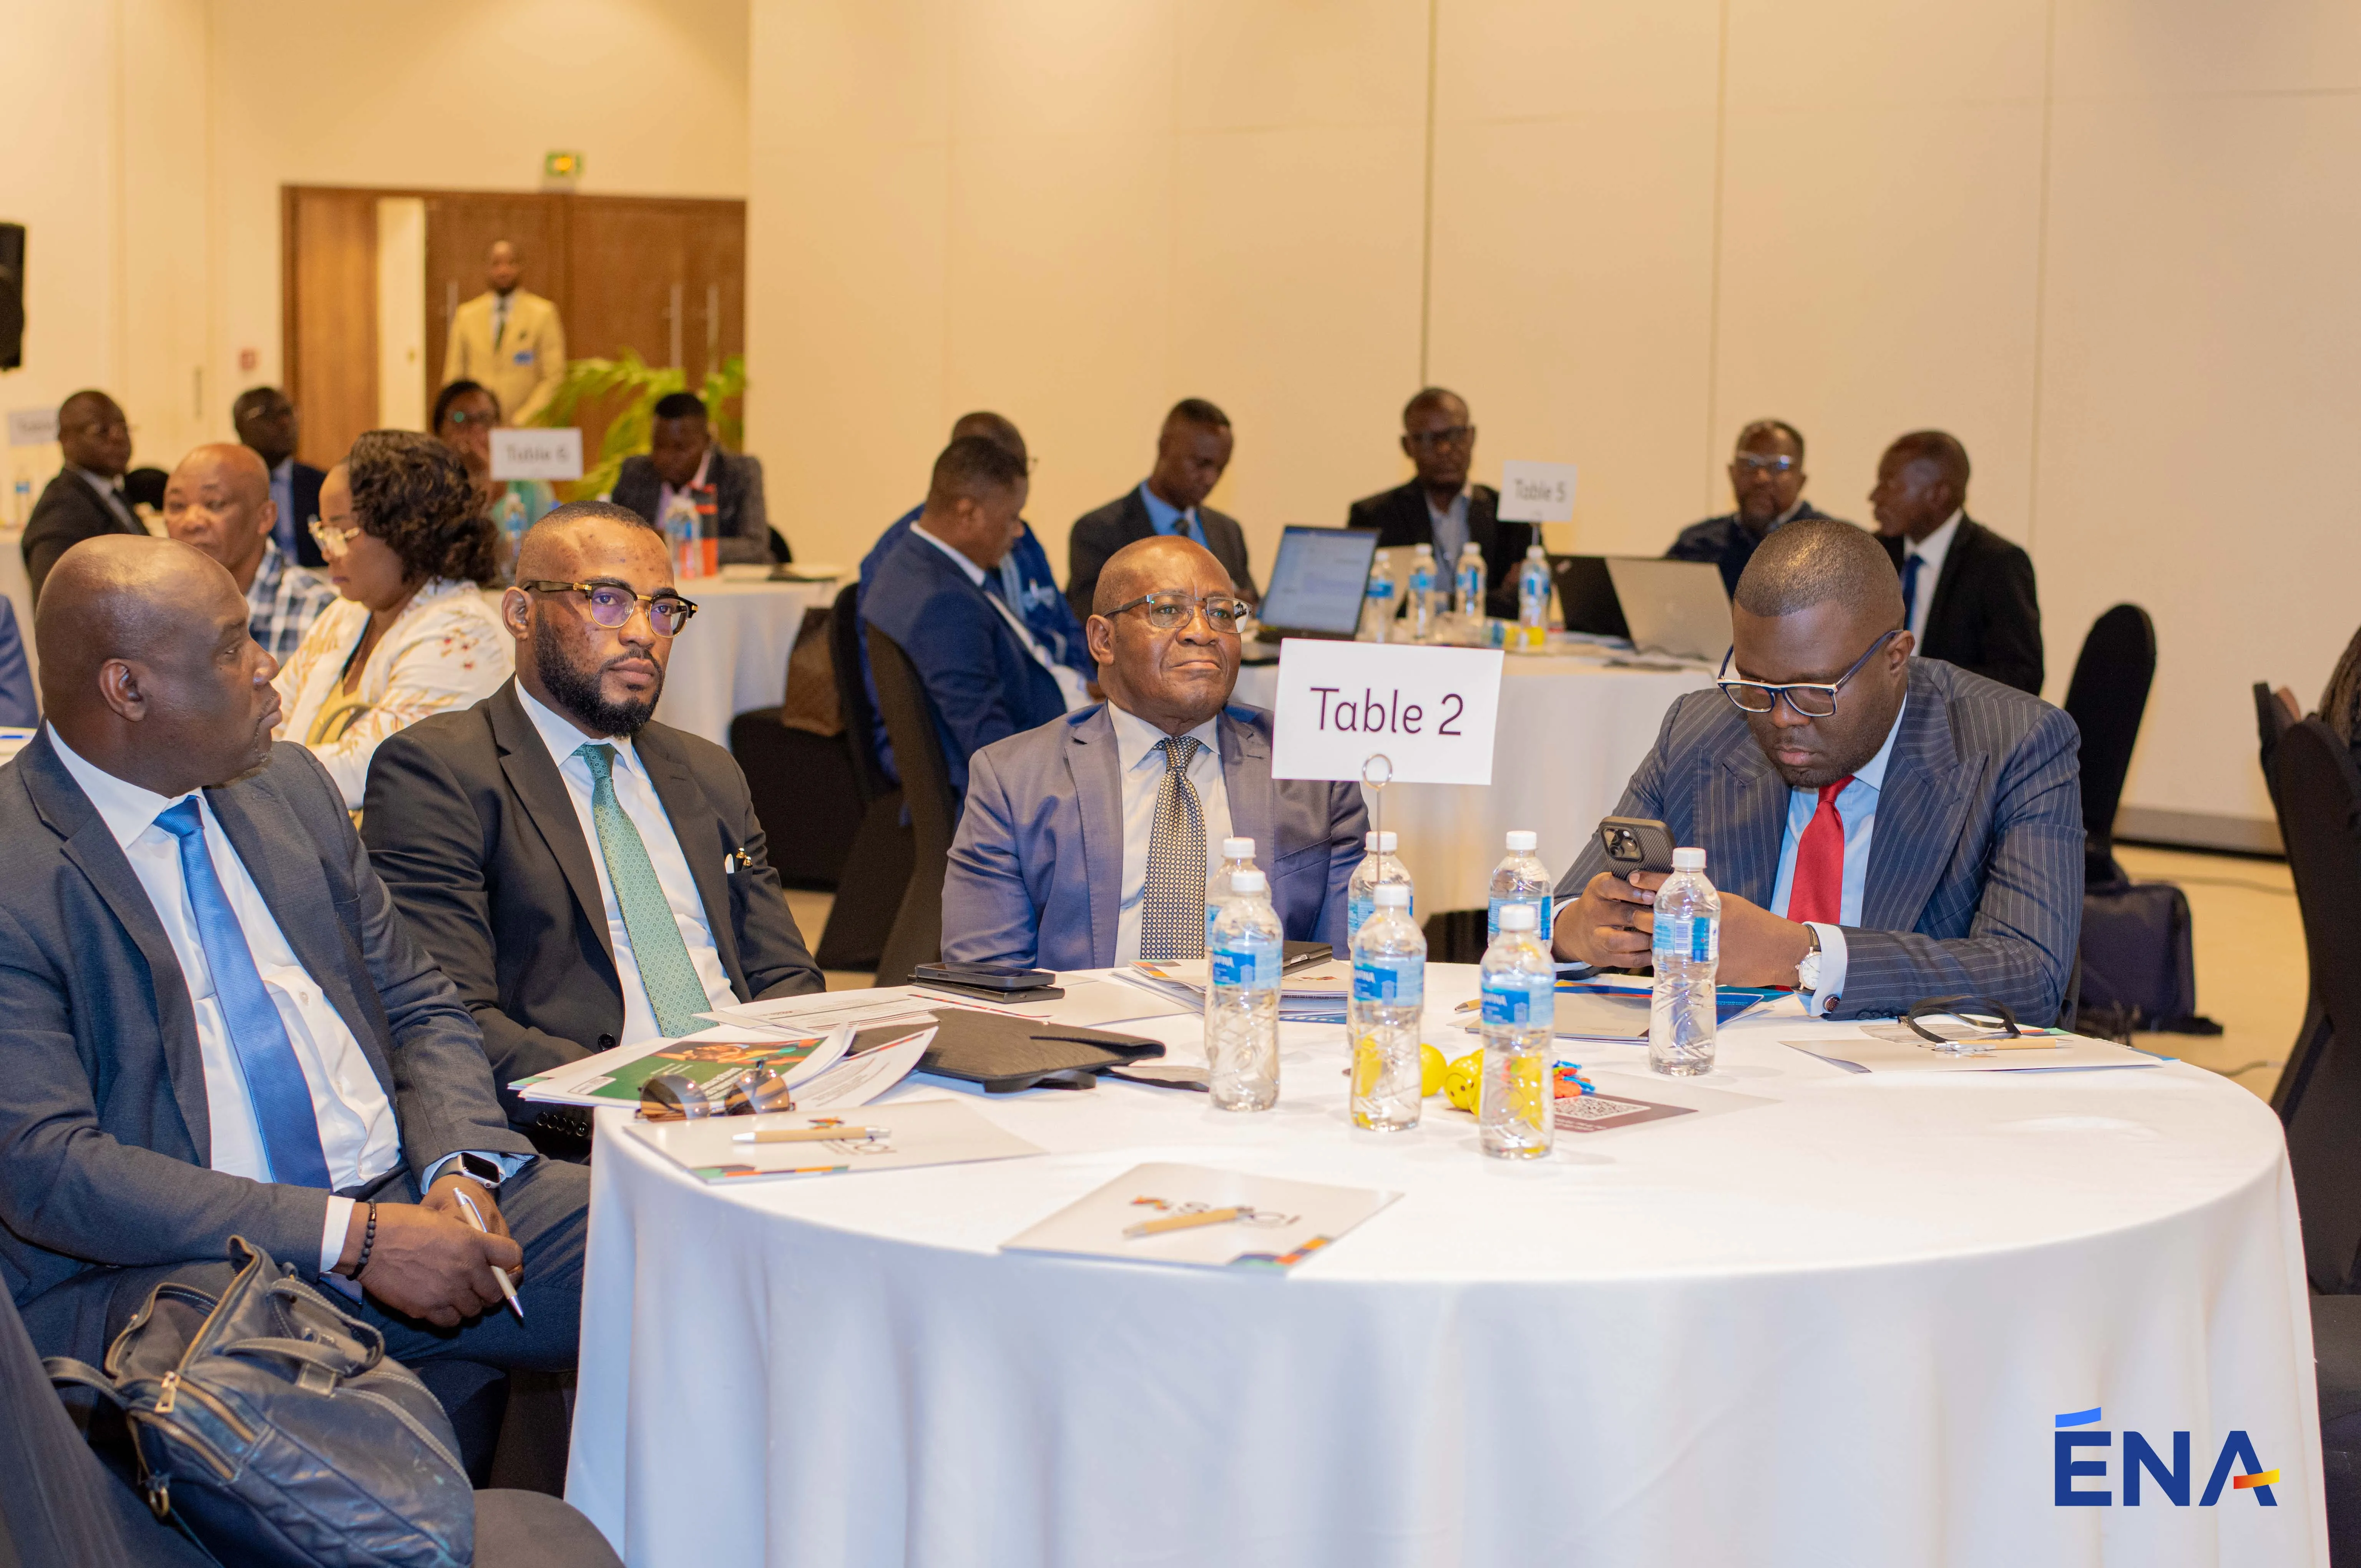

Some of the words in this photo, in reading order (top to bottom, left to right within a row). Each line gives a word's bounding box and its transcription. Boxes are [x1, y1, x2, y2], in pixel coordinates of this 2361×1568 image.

[1514, 477, 1552, 502] Table
[1310, 687, 1423, 734] Table
[1438, 693, 1464, 736] 2
